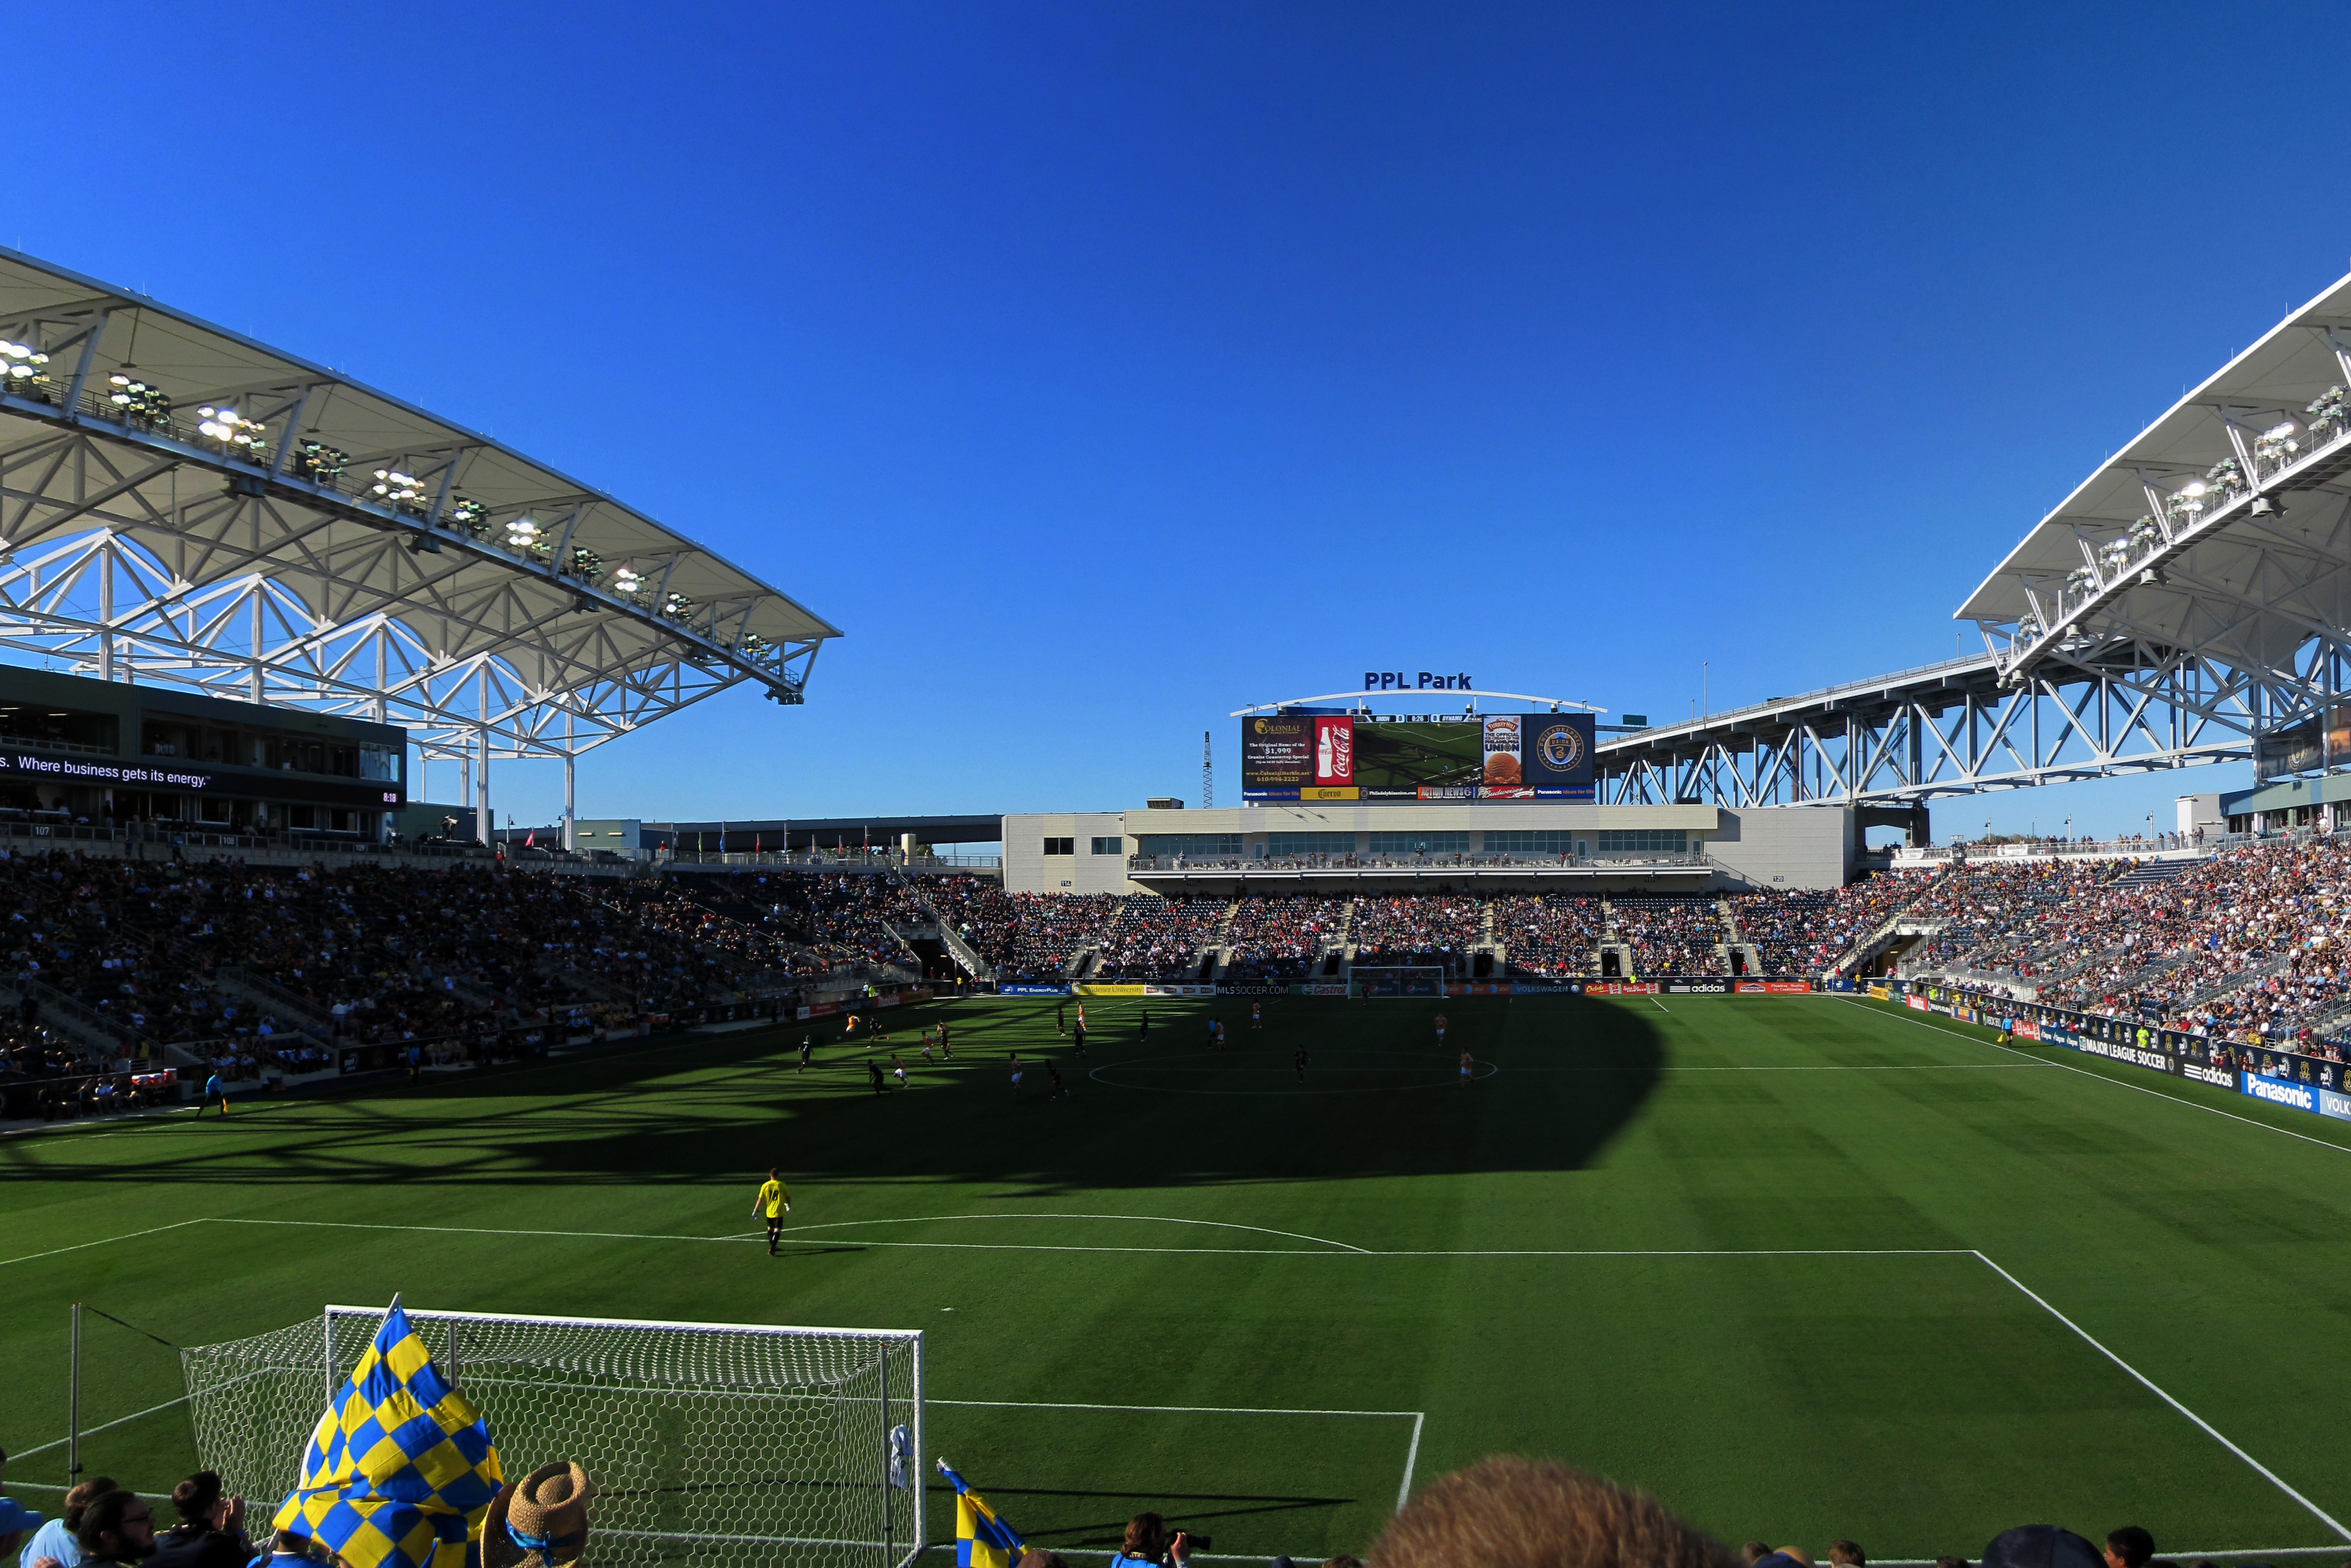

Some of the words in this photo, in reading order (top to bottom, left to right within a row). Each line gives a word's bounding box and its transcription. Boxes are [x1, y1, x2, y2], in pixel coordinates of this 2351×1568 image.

[1365, 672, 1410, 690] PPL
[1418, 672, 1472, 690] Park
[1540, 727, 1580, 747] PHILADELPHIA
[18, 756, 60, 772] Where
[64, 761, 119, 777] business
[122, 769, 147, 782] gets
[151, 769, 164, 781] its
[383, 792, 396, 802] 8:18
[1318, 789, 1341, 799] Cuervo
[1421, 787, 1444, 796] ACTION
[1445, 787, 1463, 796] NEWS
[1484, 787, 1524, 798] Budweiser
[35, 826, 50, 835] 107
[223, 837, 235, 845] 108
[1217, 986, 1288, 994] MLSSOCCER.COM
[1313, 985, 1346, 994] Castrol
[1692, 984, 1725, 992] adidas
[1909, 996, 1925, 1011] Makita
[1931, 1004, 1950, 1013] TELEFUTURA
[2086, 1038, 2108, 1056] MAJOR
[2109, 1043, 2136, 1063] LEAGUE
[2137, 1048, 2166, 1070] SOCCER
[2202, 1066, 2233, 1088] adidas
[2320, 1071, 2329, 1082] ppl
[2247, 1073, 2312, 1109] Panasonic
[2326, 1096, 2351, 1115] VOLK
